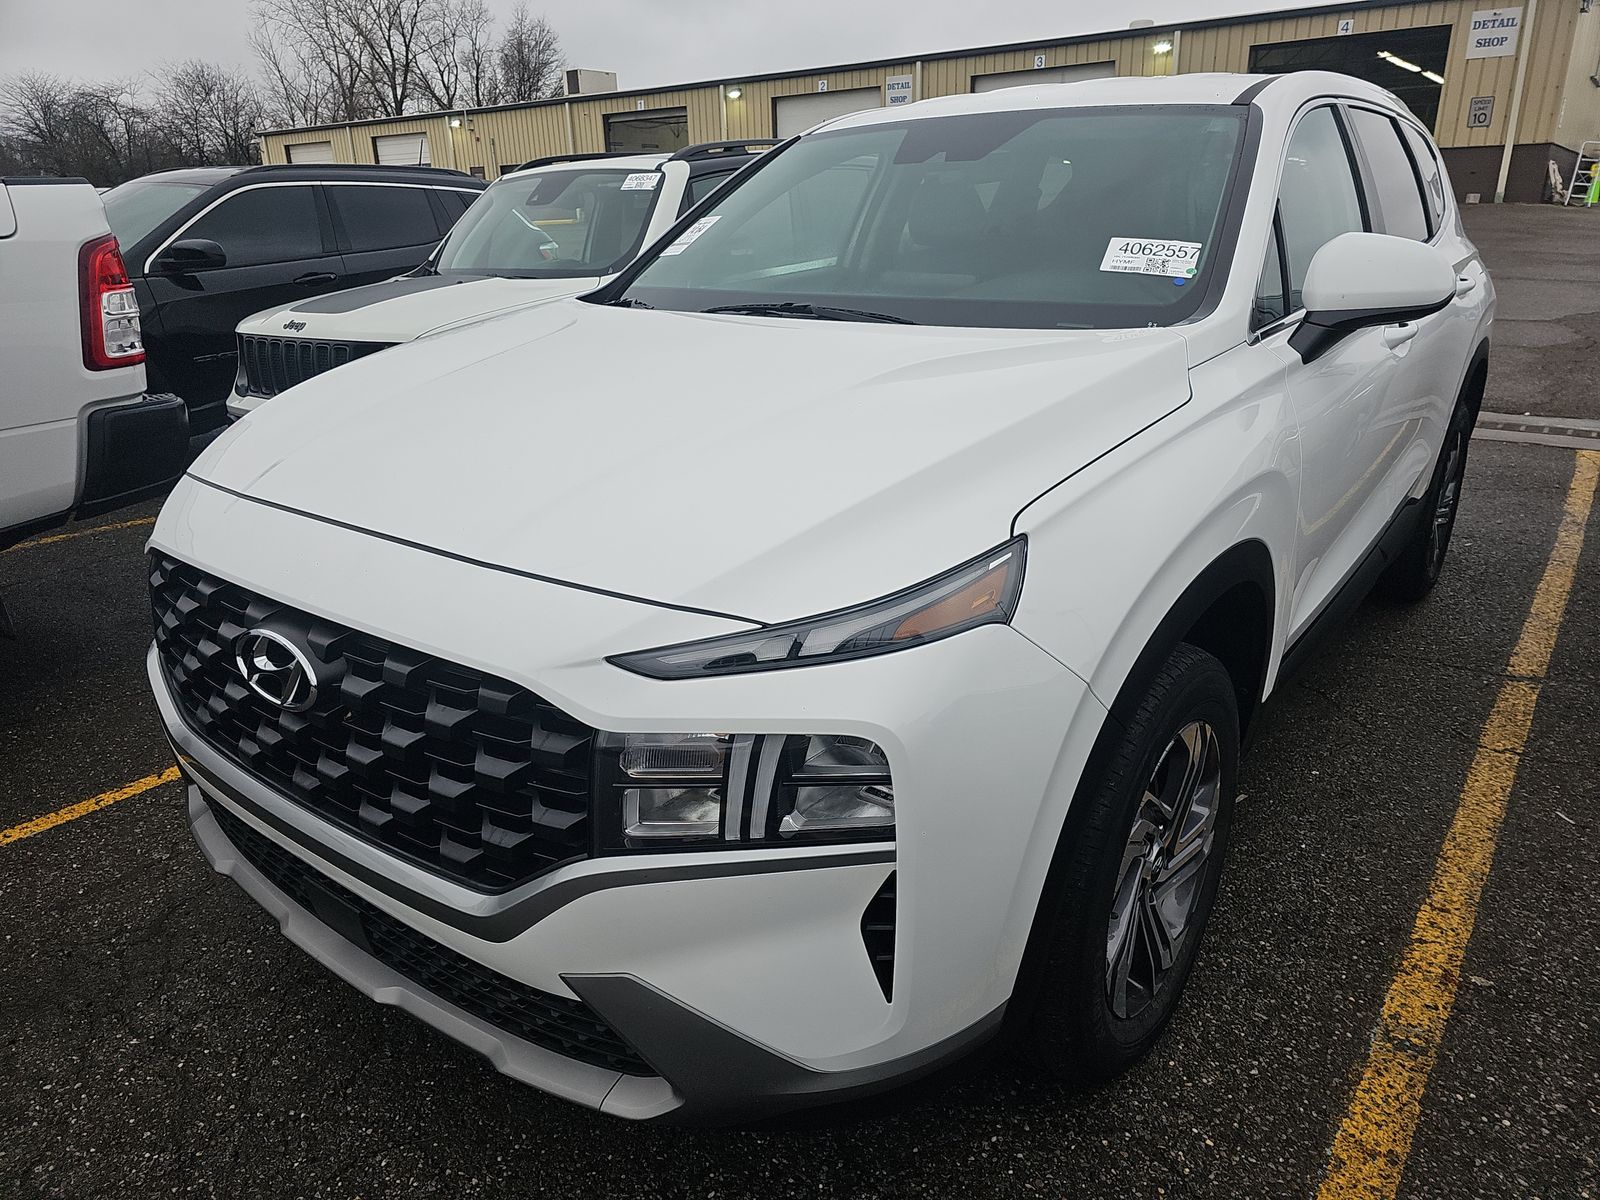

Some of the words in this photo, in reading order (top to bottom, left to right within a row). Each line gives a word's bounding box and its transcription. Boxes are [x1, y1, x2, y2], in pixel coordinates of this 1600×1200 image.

[1340, 22, 1349, 33] 4
[1472, 17, 1518, 30] DETAIL
[1475, 36, 1508, 48] SHOP
[1036, 56, 1043, 67] 3
[820, 81, 826, 91] 2
[887, 82, 911, 91] DETAIL
[890, 96, 907, 104] SHOP
[1472, 113, 1487, 124] 10
[1118, 242, 1200, 260] 4062557
[283, 319, 307, 333] Jeep
